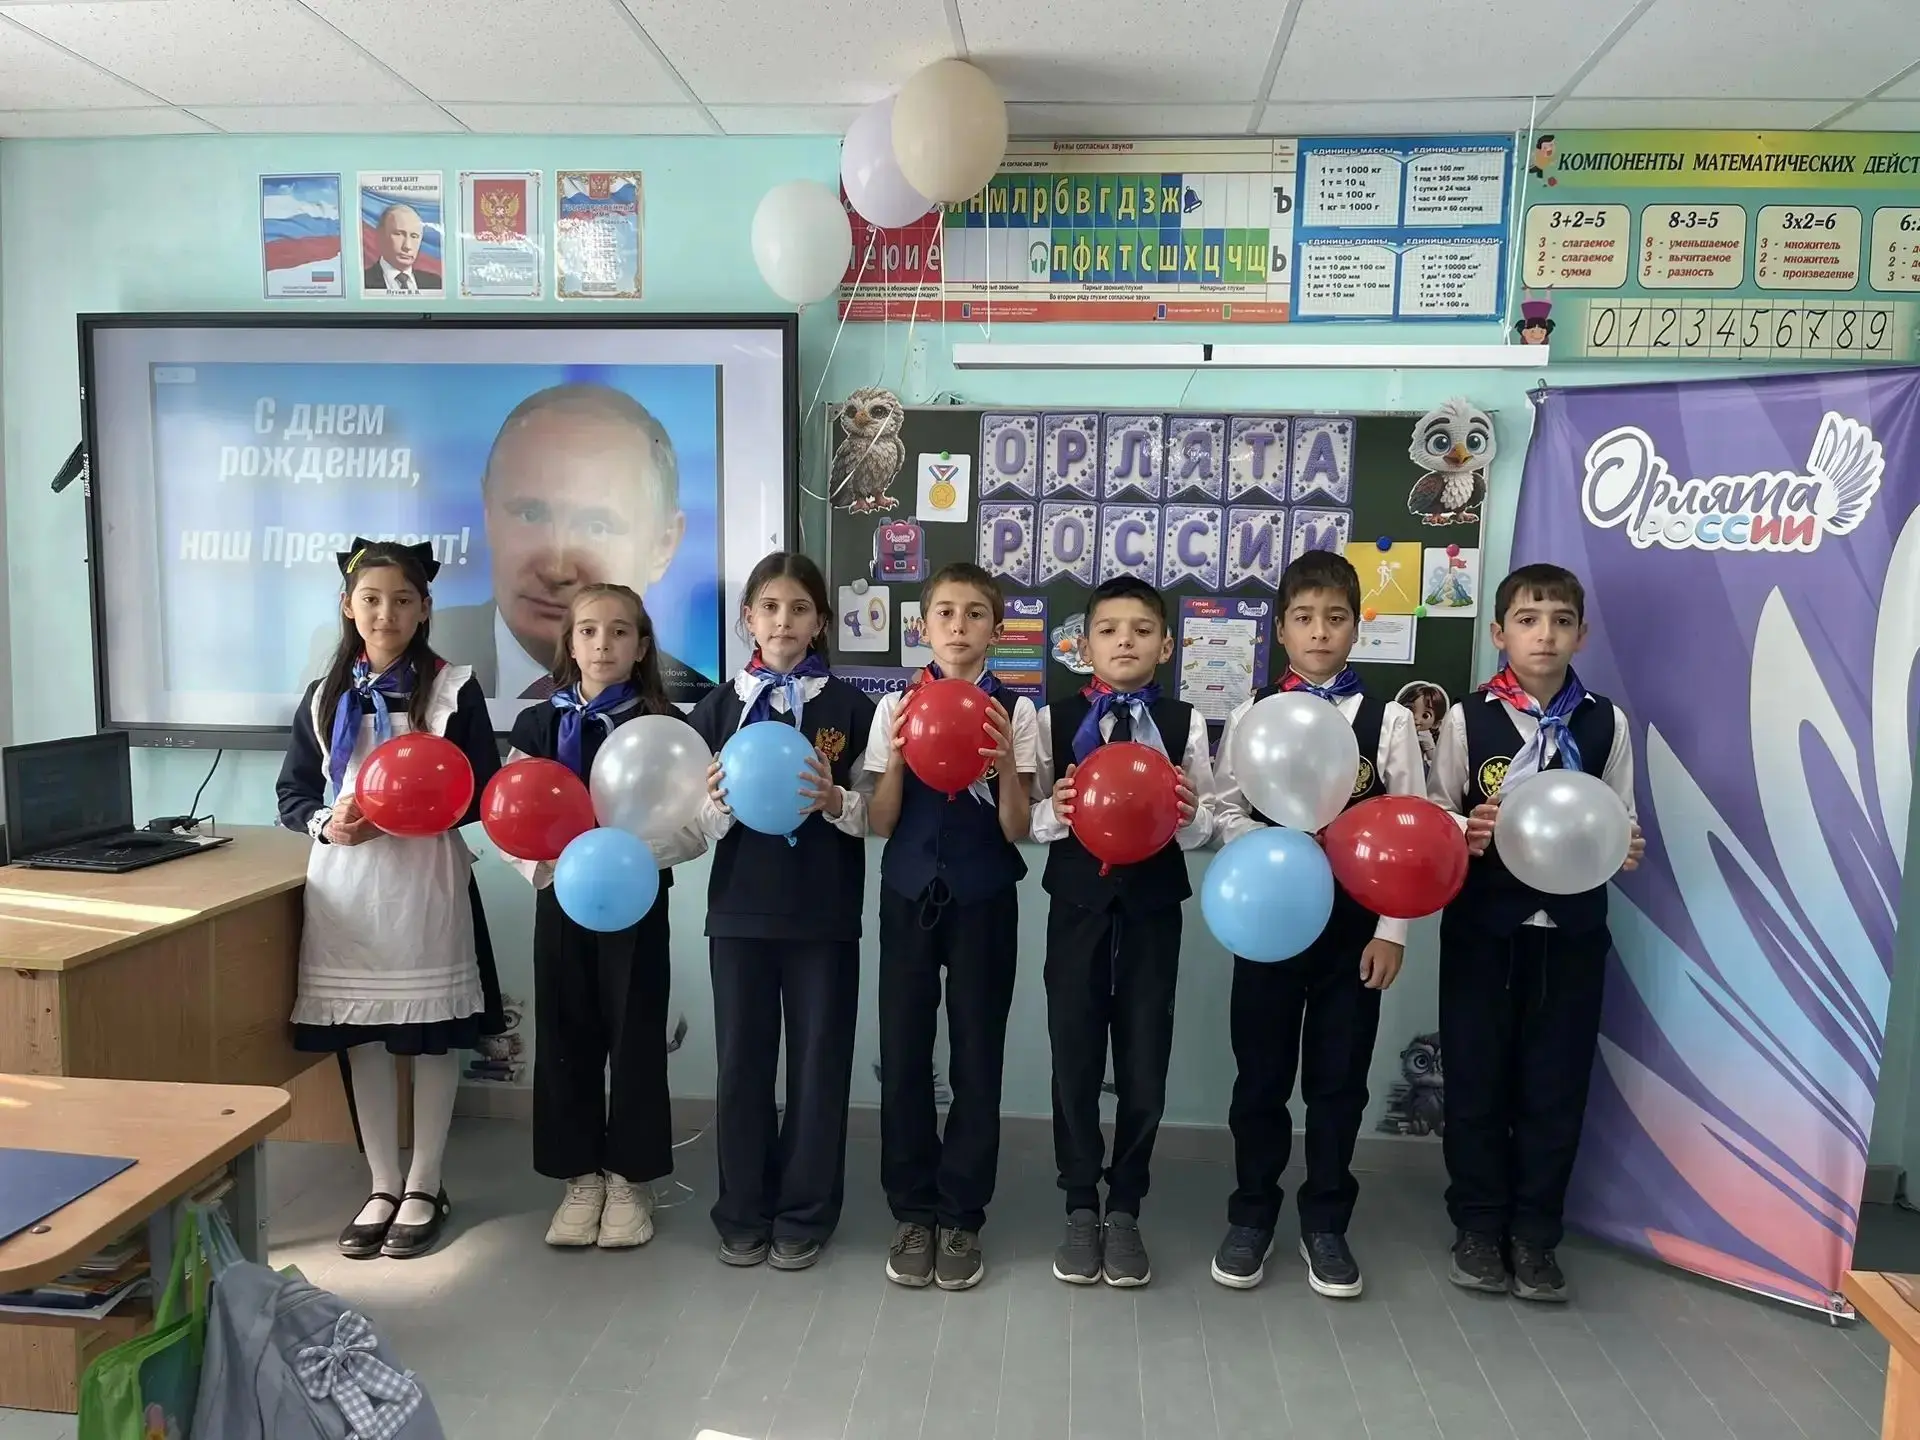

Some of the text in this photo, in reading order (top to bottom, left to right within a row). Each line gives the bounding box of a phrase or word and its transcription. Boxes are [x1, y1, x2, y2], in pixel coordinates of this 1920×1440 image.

[1053, 142, 1074, 151] Буквы
[1112, 144, 1134, 152] звуков
[1558, 152, 1684, 171] КОМПОНЕНТЫ
[1693, 153, 1856, 173] МАТЕМАТИЧЕСКИХ
[1346, 166, 1369, 174] 1000
[1349, 203, 1372, 211] 1000
[1550, 211, 1606, 228] 3+2=5
[1669, 211, 1719, 228] 8-3=5
[1539, 237, 1546, 247] 3
[1645, 237, 1740, 249] 8 уменьшаемое
[1760, 238, 1841, 249] 3 множитель
[1889, 242, 1896, 252] 6
[1538, 252, 1614, 262] 2 слагаемое
[1645, 251, 1731, 262] 3 вычитаемое
[1760, 252, 1840, 264] 2 множитель
[1888, 256, 1896, 267] 2
[1537, 266, 1591, 278] 5 сумма
[1644, 266, 1714, 278] 5 разность
[1760, 267, 1854, 280] 6 произведение
[1887, 271, 1895, 281] 3
[254, 397, 385, 440] С днем
[995, 428, 1341, 484] ОРЛЯТА
[217, 446, 420, 487] рождения,
[1588, 432, 1823, 533] Орлята
[179, 530, 252, 563] наш
